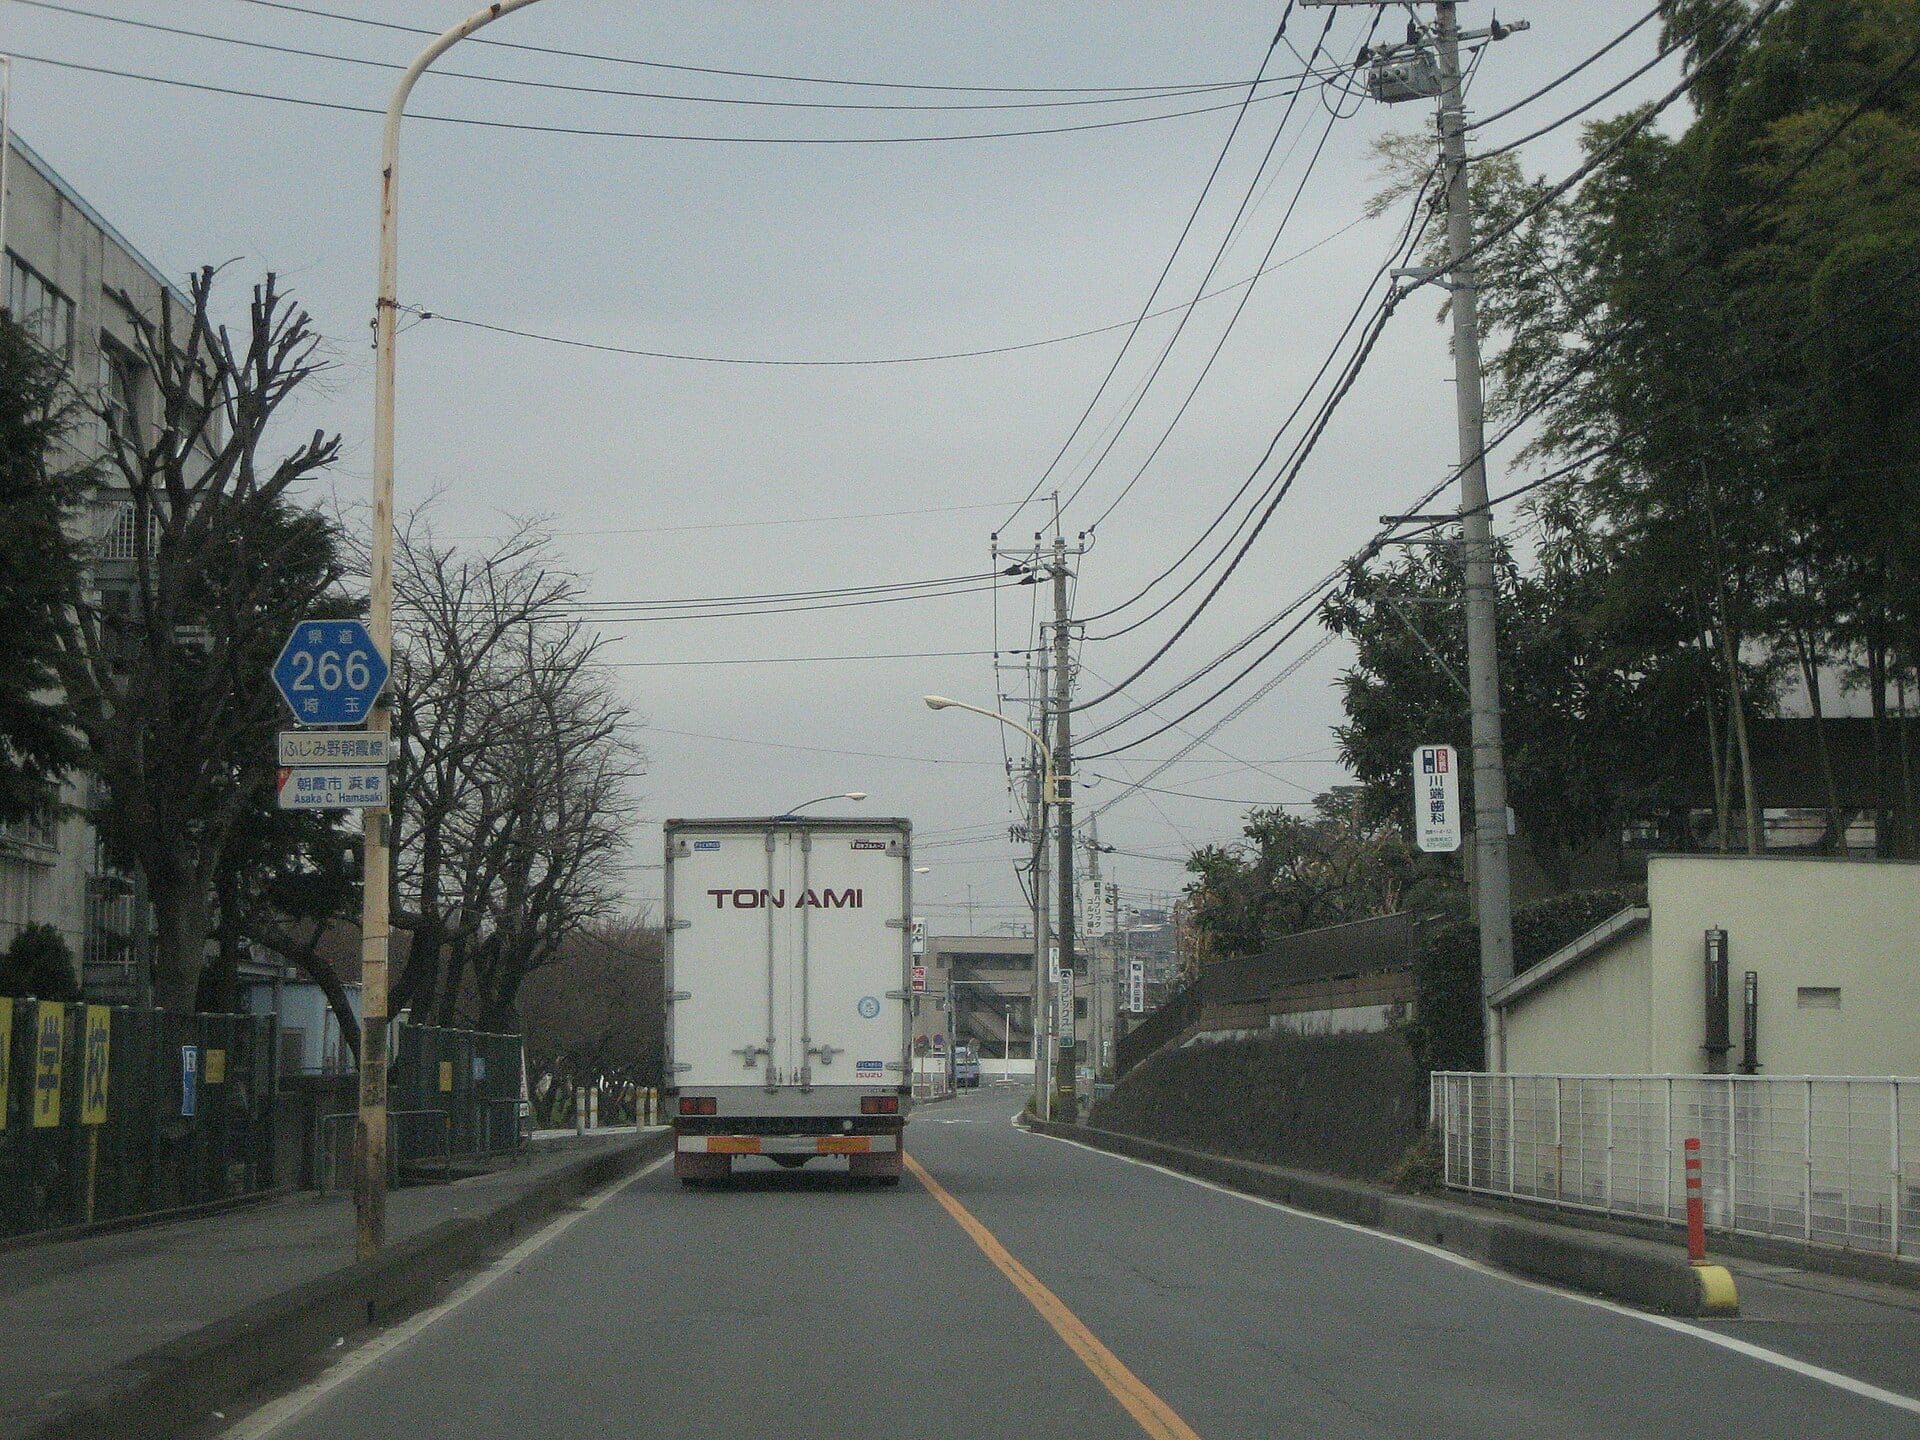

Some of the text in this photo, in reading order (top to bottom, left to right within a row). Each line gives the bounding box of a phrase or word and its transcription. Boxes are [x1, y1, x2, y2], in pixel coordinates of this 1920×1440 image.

[308, 630, 353, 644] 県道
[292, 651, 370, 691] 266
[303, 698, 360, 714] 埼玉
[284, 740, 383, 757] ふじみ野朝霞線
[297, 777, 342, 792] 朝霞市
[295, 793, 322, 804] Asaka
[339, 792, 383, 803] Hamasaki
[1429, 775, 1445, 825] 川端歯科
